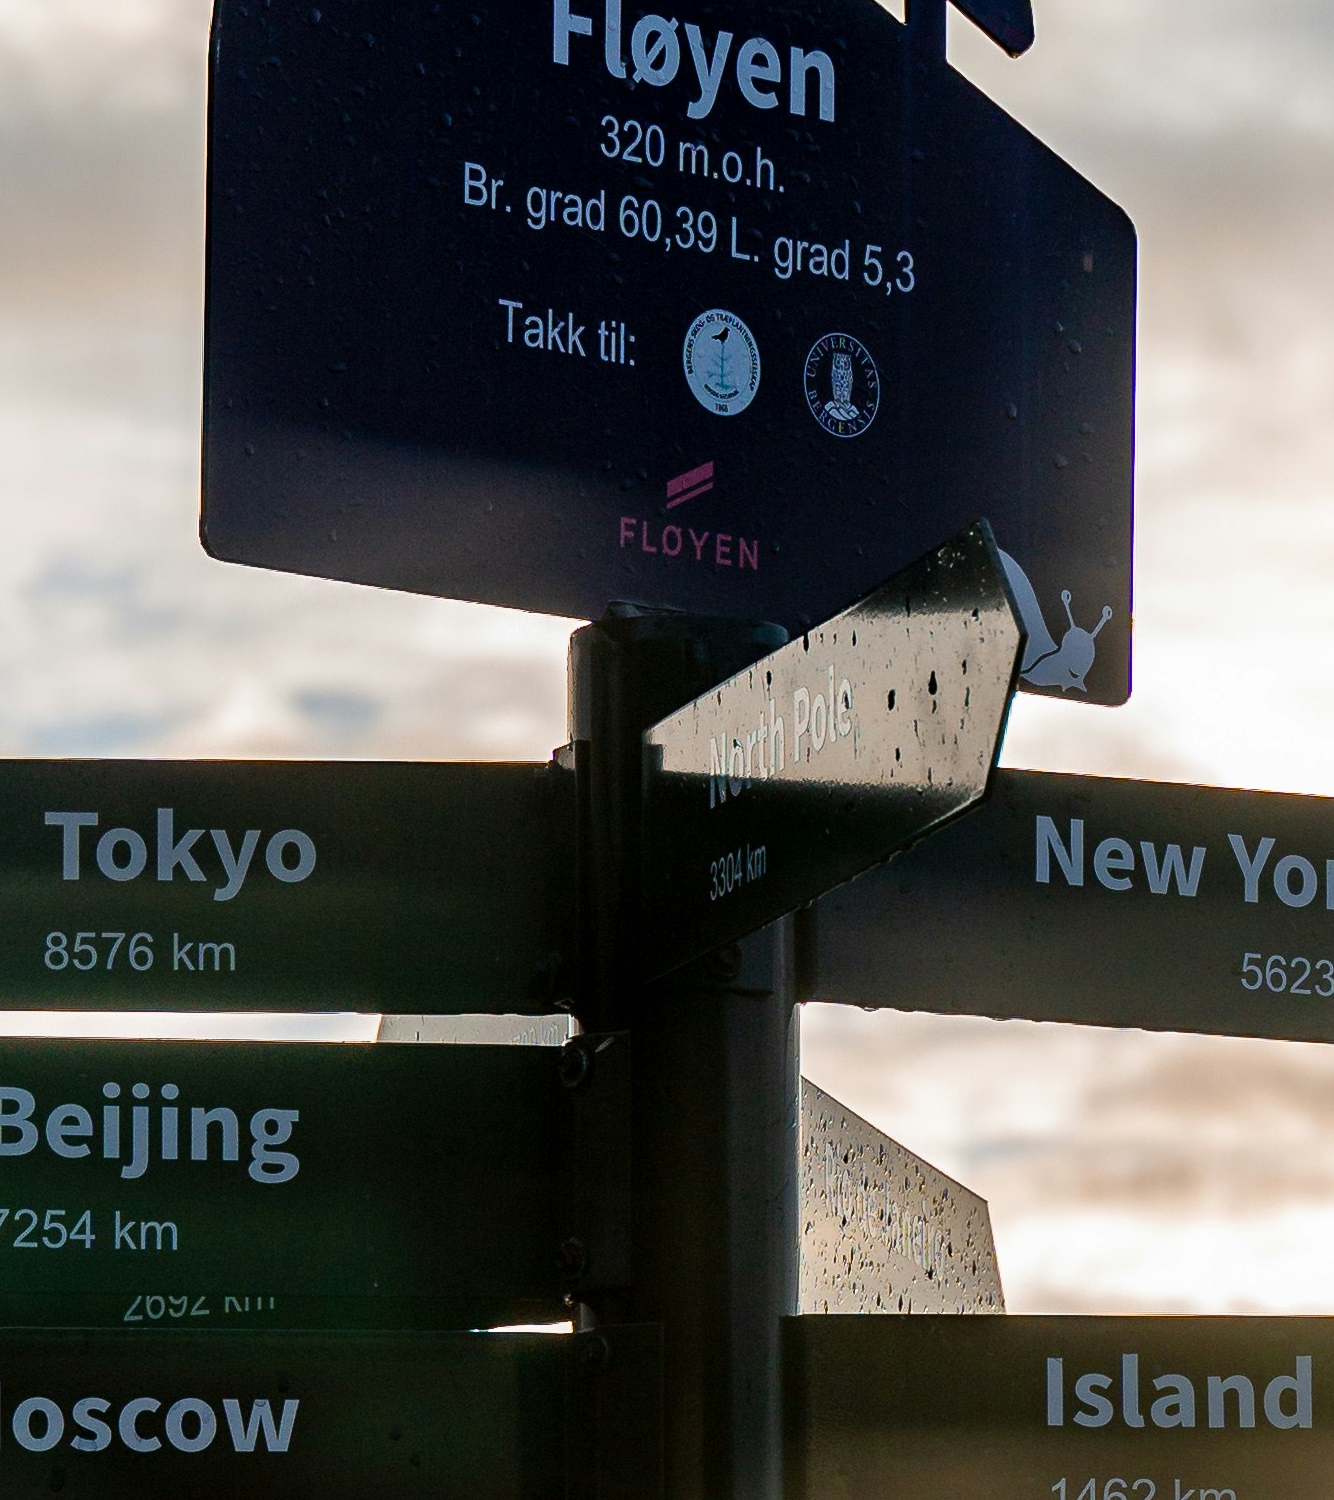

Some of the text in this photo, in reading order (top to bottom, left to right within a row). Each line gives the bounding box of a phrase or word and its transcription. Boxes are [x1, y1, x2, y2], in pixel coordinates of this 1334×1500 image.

[600, 114, 785, 193] 320 m.o.h.
[463, 161, 916, 296] Br. grad 60,39 L. grad 5,3
[498, 298, 636, 366] Takk til:
[806, 337, 877, 389] UNIVERSITAS
[808, 389, 875, 434] BERGENSIS
[619, 516, 758, 570] FLØYEN
[710, 664, 853, 810] North Pole
[44, 807, 317, 902] Tokyo
[709, 844, 767, 901] 3304 km
[1035, 815, 1207, 897] New
[44, 931, 236, 971] 8576 km
[114, 1210, 178, 1251] km
[1047, 1353, 1313, 1430] Island
